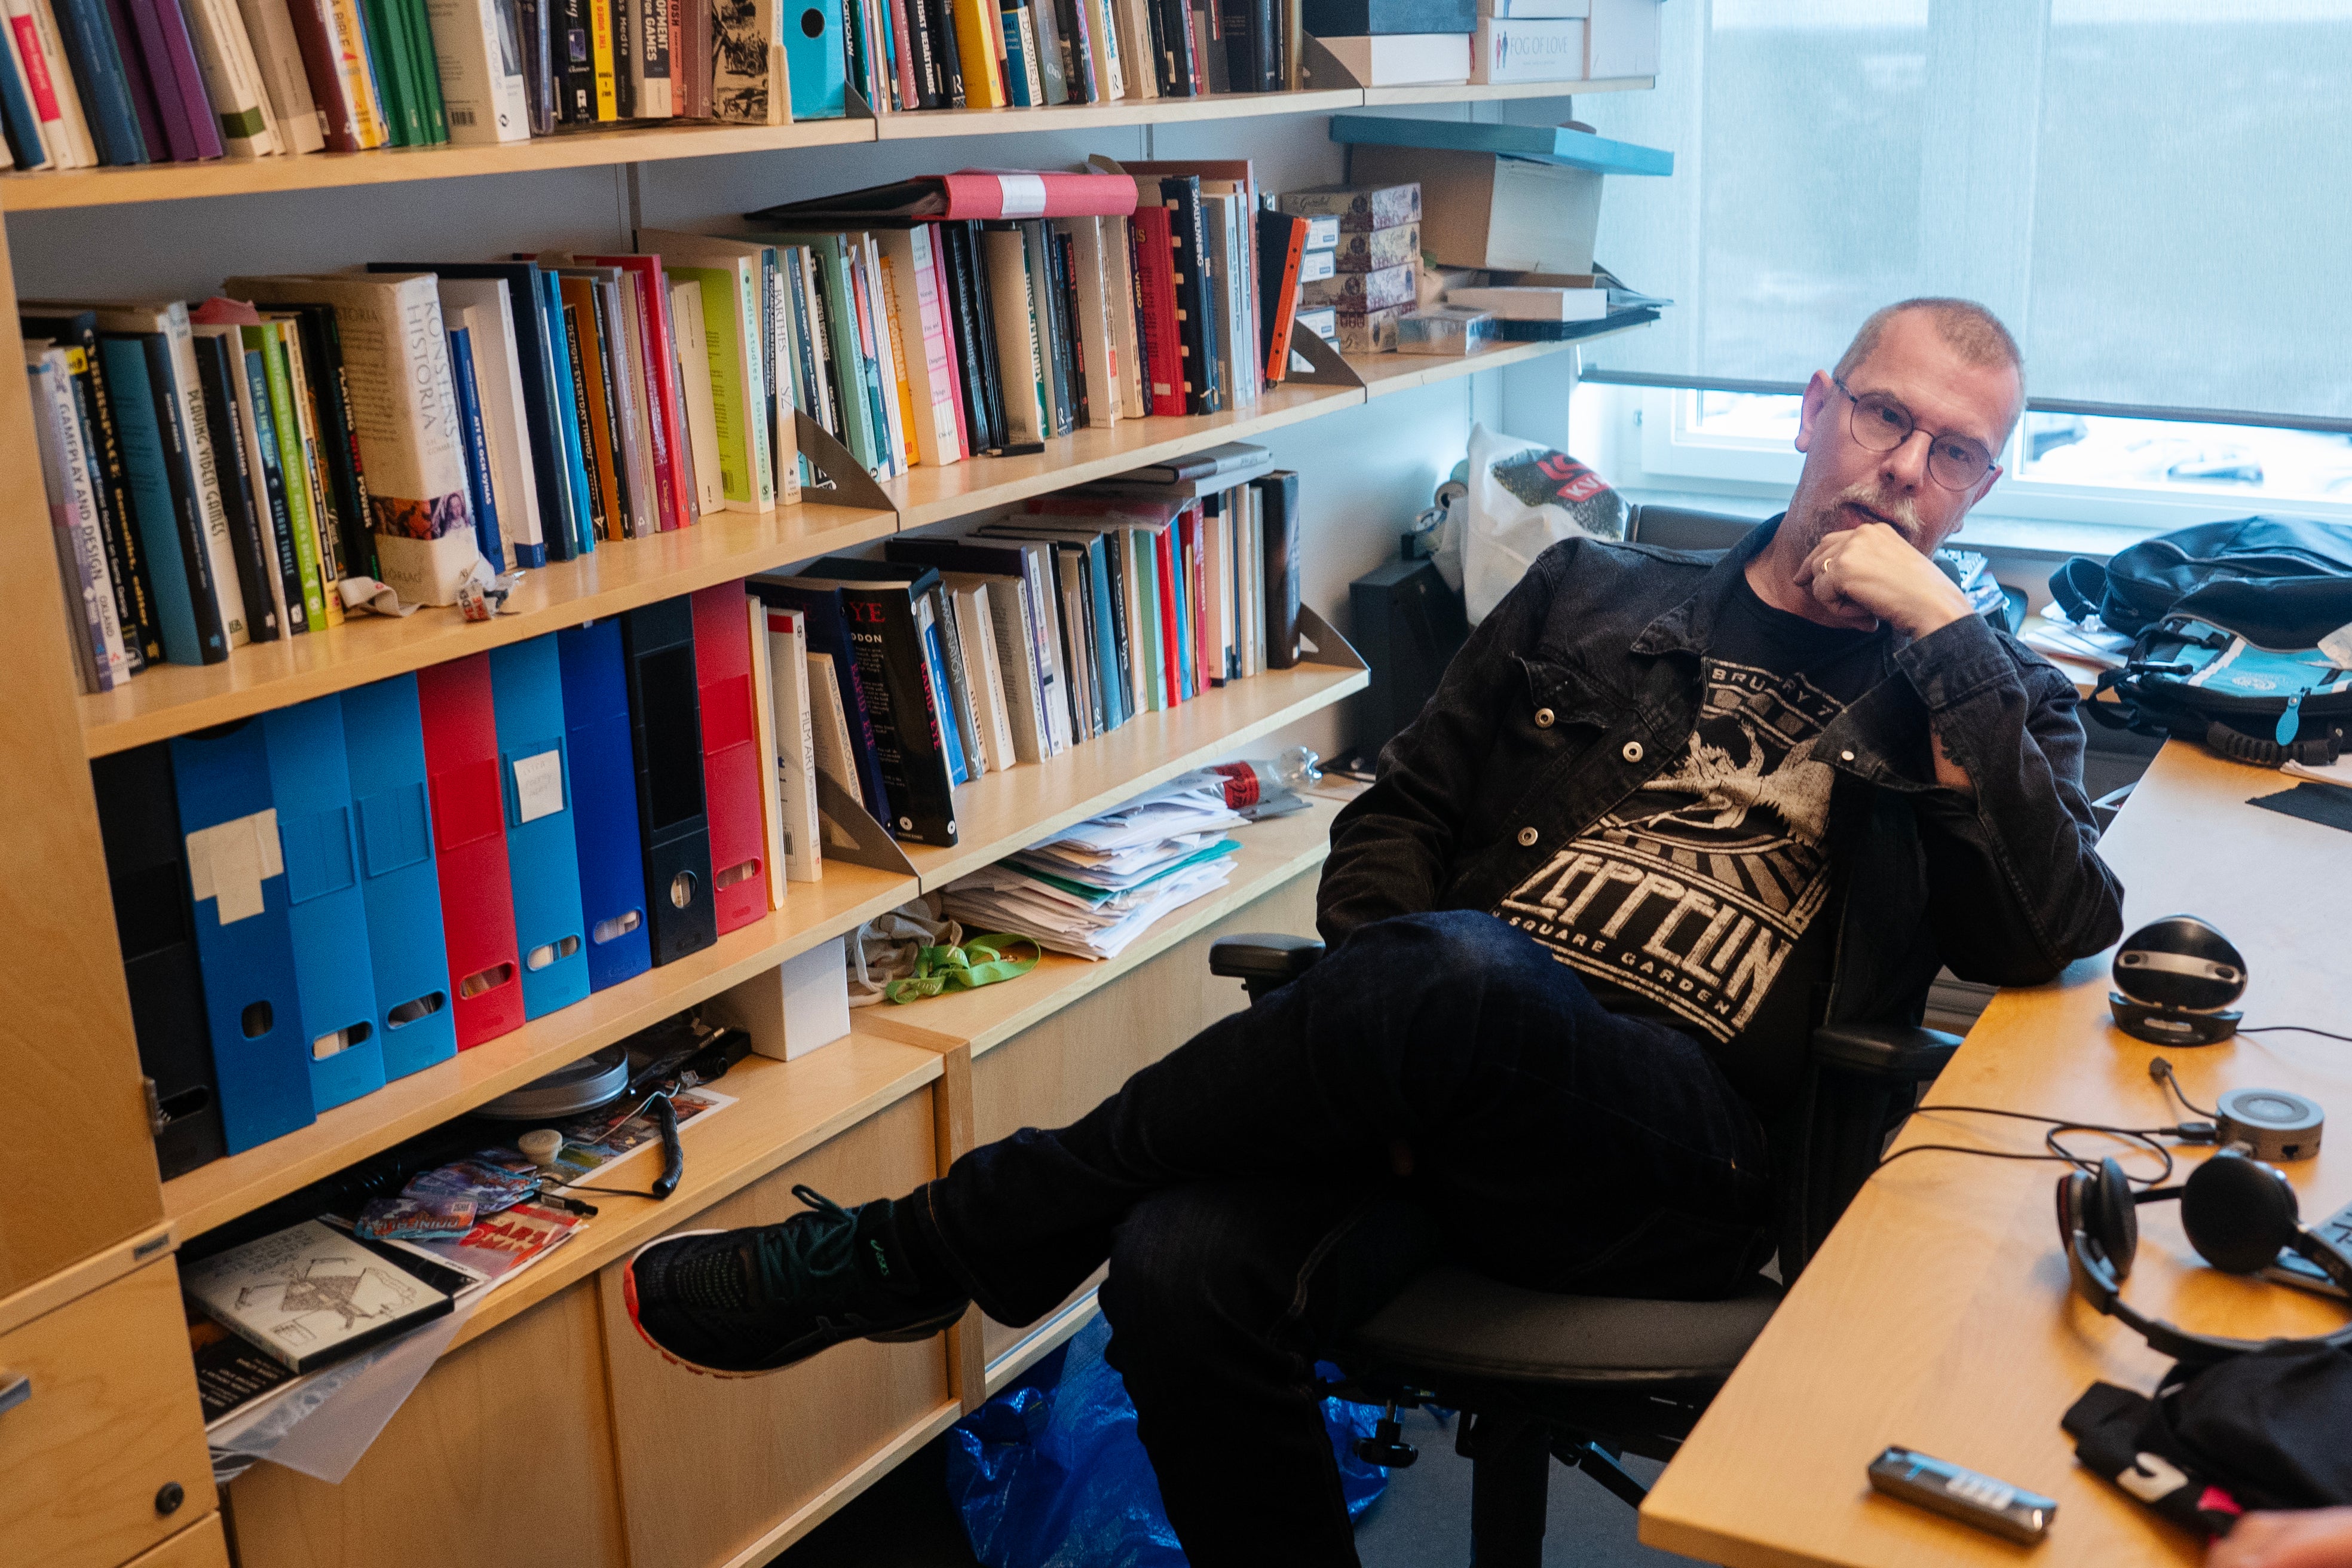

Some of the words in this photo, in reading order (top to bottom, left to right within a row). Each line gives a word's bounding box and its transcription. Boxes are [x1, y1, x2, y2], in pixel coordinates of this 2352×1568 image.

[596, 6, 605, 31] VIDEO
[619, 16, 628, 56] Media
[645, 17, 657, 60] GAMES
[920, 30, 936, 94] BERÄTTANDE
[1509, 36, 1530, 54] FOG
[1532, 36, 1544, 54] OF
[1546, 36, 1567, 54] LOVE
[1066, 241, 1074, 280] CINEMA
[744, 289, 755, 325] media
[795, 278, 806, 308] SEXUAL
[881, 268, 896, 317] ERVING
[956, 268, 970, 313] Making
[774, 288, 786, 353] BARTHES
[800, 308, 810, 341] SUBJECT
[961, 314, 976, 368] Meaning
[407, 304, 437, 430] HISTORIA
[425, 299, 458, 438] KONSTENS
[747, 332, 761, 381] studies
[888, 317, 906, 382] GOFFMAN
[1029, 318, 1043, 384] THEORY
[253, 376, 263, 397] LIFE
[256, 397, 266, 413] ON
[573, 369, 587, 420] EVERYDAY
[628, 383, 638, 410] GAMES
[851, 326, 863, 372] Research
[864, 423, 874, 451] Prosser
[186, 388, 209, 445] PLAYING
[229, 400, 249, 476] Remediation
[259, 414, 269, 431] THE
[472, 415, 482, 433] ATT
[58, 403, 85, 485] GAMEPLAY
[337, 366, 356, 431] PLAYING
[356, 475, 372, 529] POWER
[475, 434, 483, 448] SE
[477, 448, 488, 472] OCH
[756, 428, 767, 474] Devereux
[82, 327, 121, 479] CYBERSPACE
[131, 574, 149, 627] editor
[197, 448, 217, 488] VIDEO
[75, 488, 92, 522] AND
[205, 489, 226, 537] GAMES
[280, 413, 293, 452] DIGITAL
[287, 455, 299, 489] GAMES
[293, 492, 307, 532] RUTTER
[300, 540, 313, 574] BRYCE
[274, 498, 287, 535] SHERRY
[81, 524, 104, 581] DESIGN
[111, 557, 124, 585] Game
[280, 538, 294, 576] TURKLE
[1031, 566, 1040, 586] GAME
[98, 595, 115, 638] OXLAND
[115, 584, 130, 618] Design
[849, 601, 886, 623] YE
[1034, 586, 1044, 624] DEVELOPMENT
[1115, 572, 1128, 637] Downcast
[939, 597, 962, 683] IMAGINATION
[1039, 625, 1048, 654] RESEARCH
[1120, 638, 1131, 670] Eyes
[850, 663, 868, 712] RAPID
[862, 719, 875, 750] EYE
[920, 660, 935, 712] RAPID
[929, 718, 941, 751] EYE
[1711, 667, 1810, 709] BRURY
[1817, 707, 1835, 717] 7
[801, 710, 812, 743] FILM
[973, 710, 984, 747] SKRIVA
[803, 744, 814, 771] ART
[844, 749, 853, 769] OCH
[1500, 849, 1794, 1030] ZEPPELIN
[1508, 915, 1606, 954] SQUARE
[1620, 951, 1731, 1015] GARDEN
